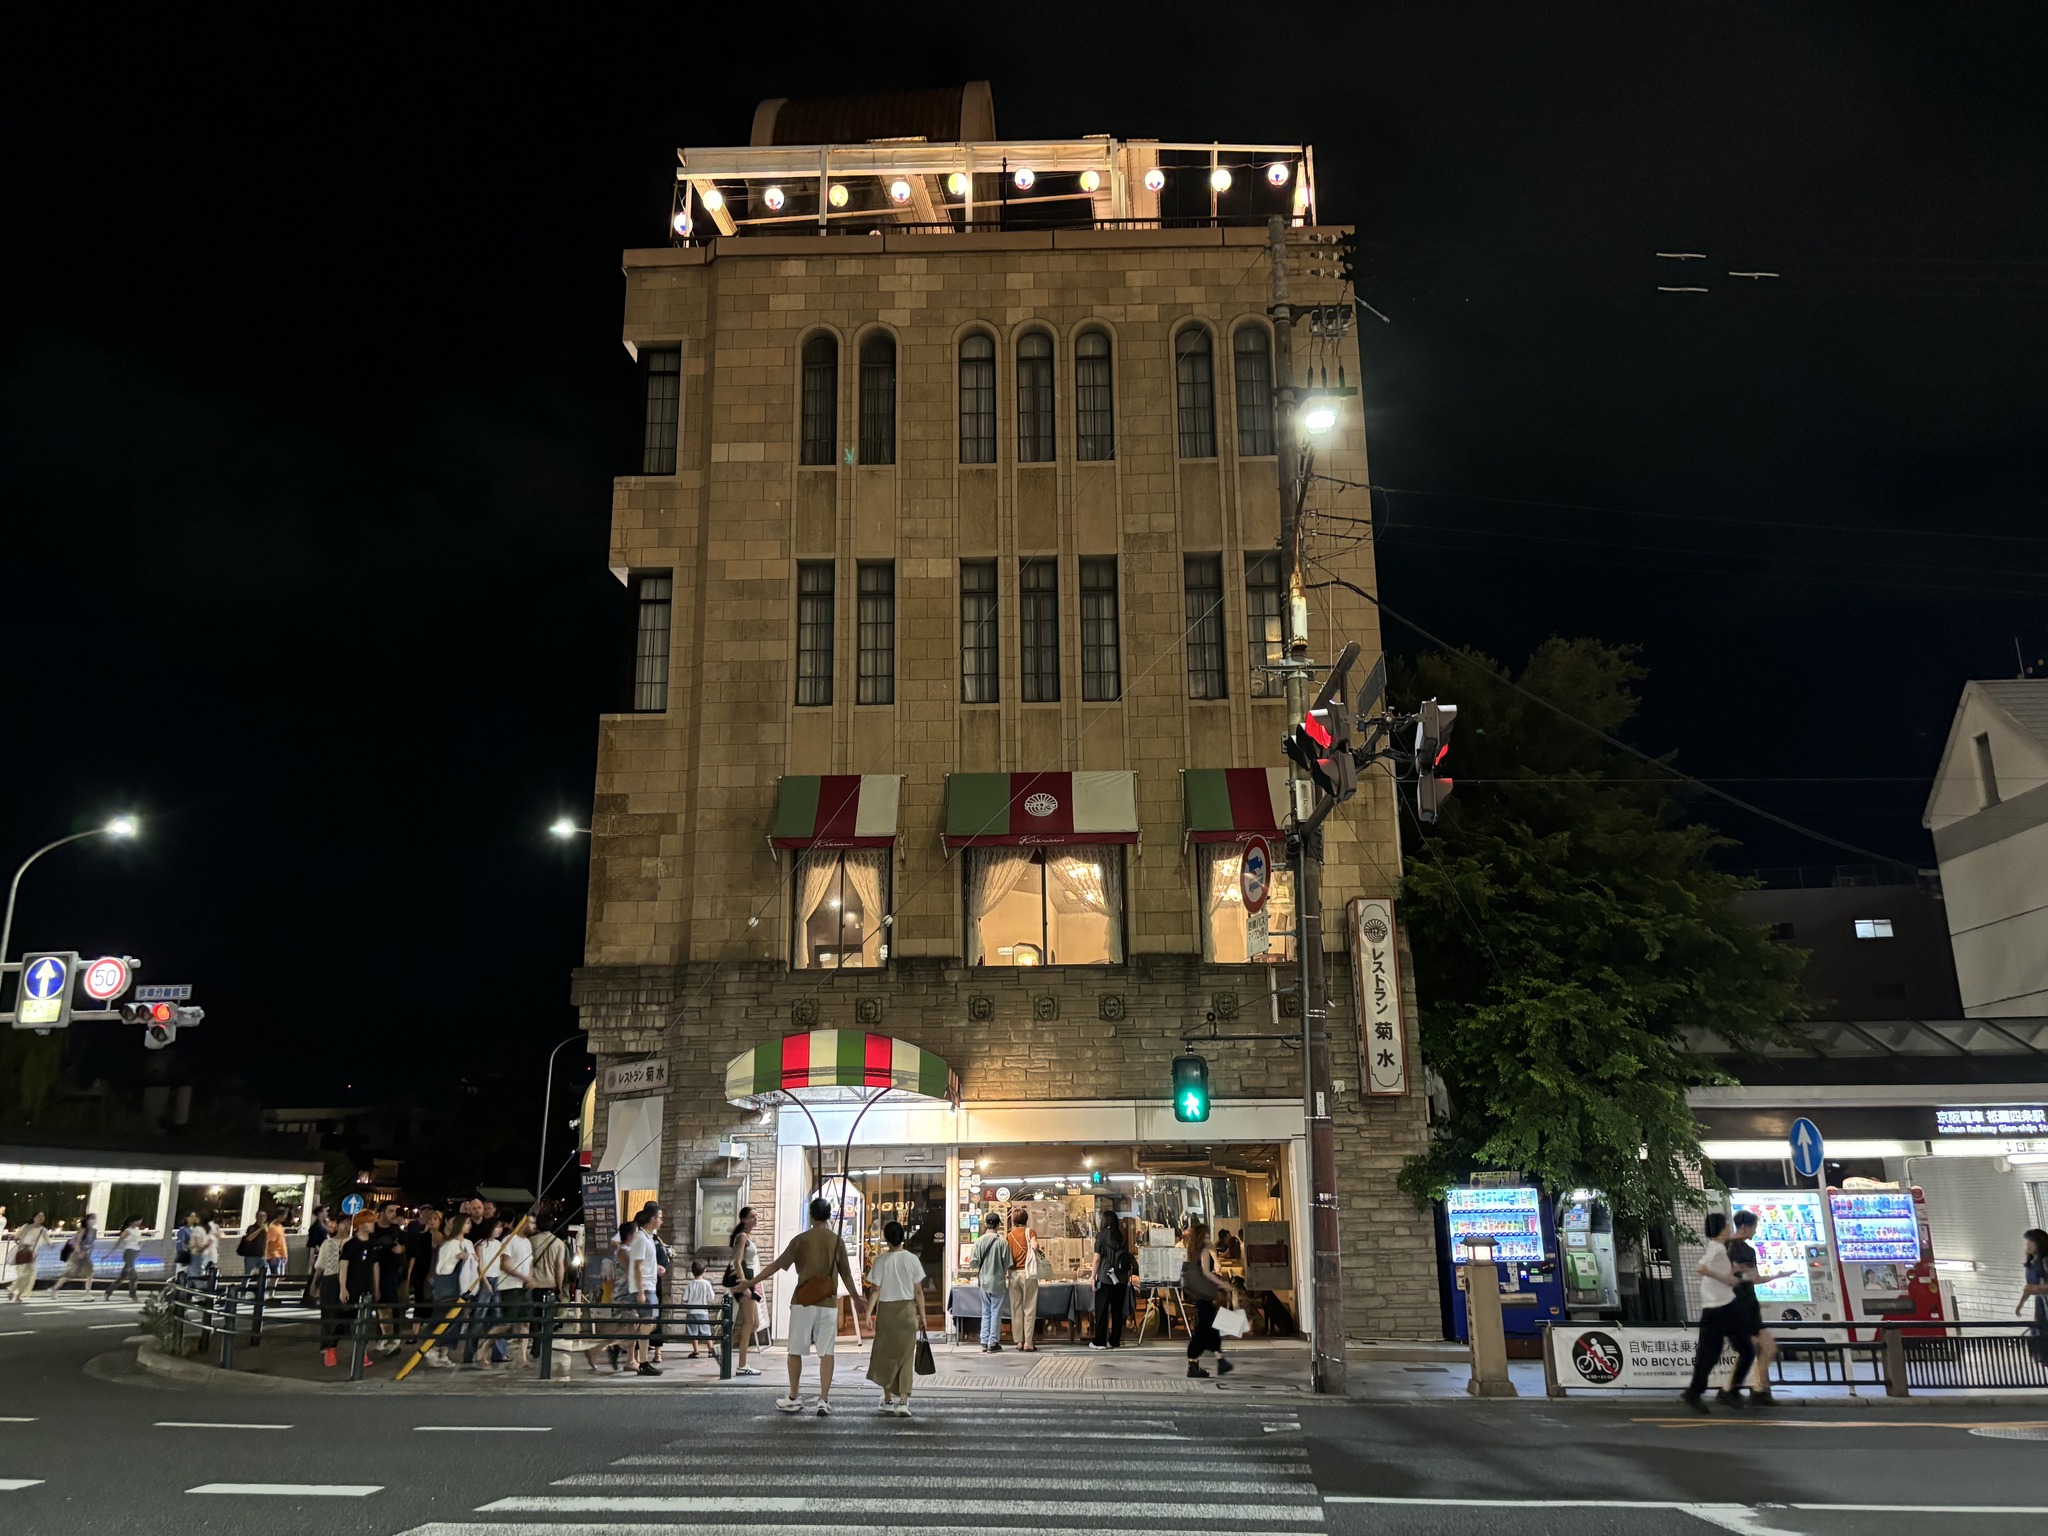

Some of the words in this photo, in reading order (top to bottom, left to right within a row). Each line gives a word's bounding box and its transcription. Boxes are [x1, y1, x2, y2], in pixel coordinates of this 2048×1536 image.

[94, 969, 117, 987] 50
[1371, 948, 1389, 1015] レストラン
[1374, 1022, 1395, 1067] 菊水
[619, 1071, 644, 1084] レストラン
[646, 1064, 665, 1082] 菊水
[1938, 1125, 1966, 1133] Keihan
[1966, 1125, 1997, 1135] Railway
[1632, 1357, 1648, 1367] NO
[1652, 1356, 1697, 1367] BICYCLE
